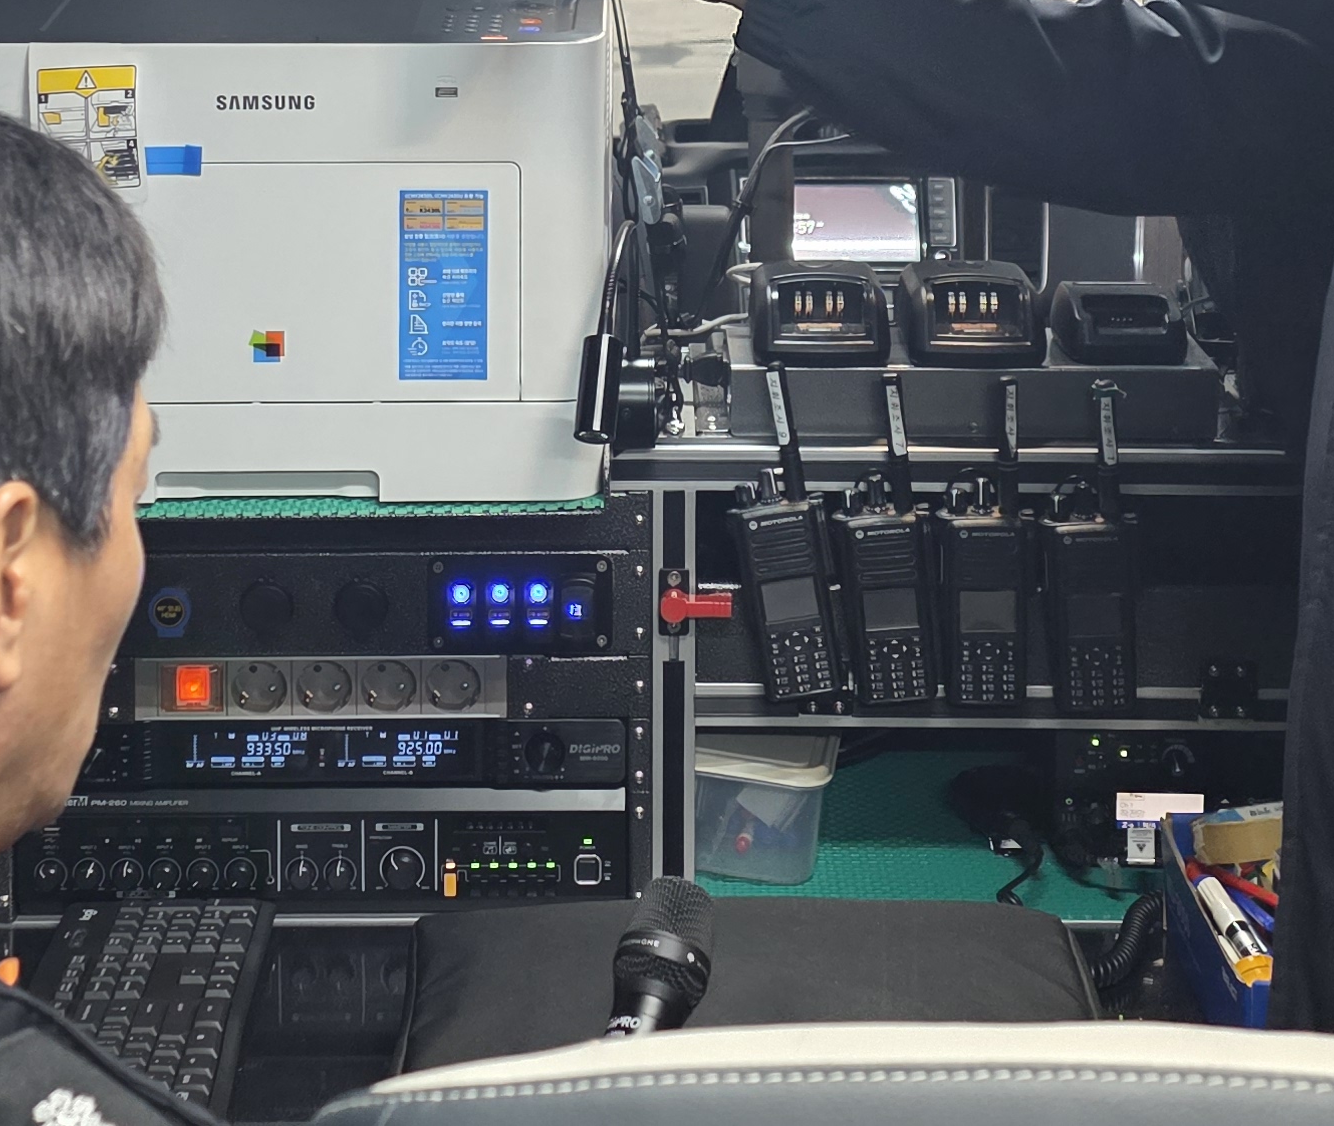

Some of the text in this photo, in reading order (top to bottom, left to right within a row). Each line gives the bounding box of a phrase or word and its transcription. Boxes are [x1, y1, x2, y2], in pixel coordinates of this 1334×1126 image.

[215, 94, 316, 111] SAMSUNG
[760, 515, 804, 527] MOTOROLA
[867, 527, 910, 536] MOTOROLA
[246, 742, 292, 756] 933.50
[397, 741, 443, 755] 925.00
[90, 799, 128, 807] PM-260
